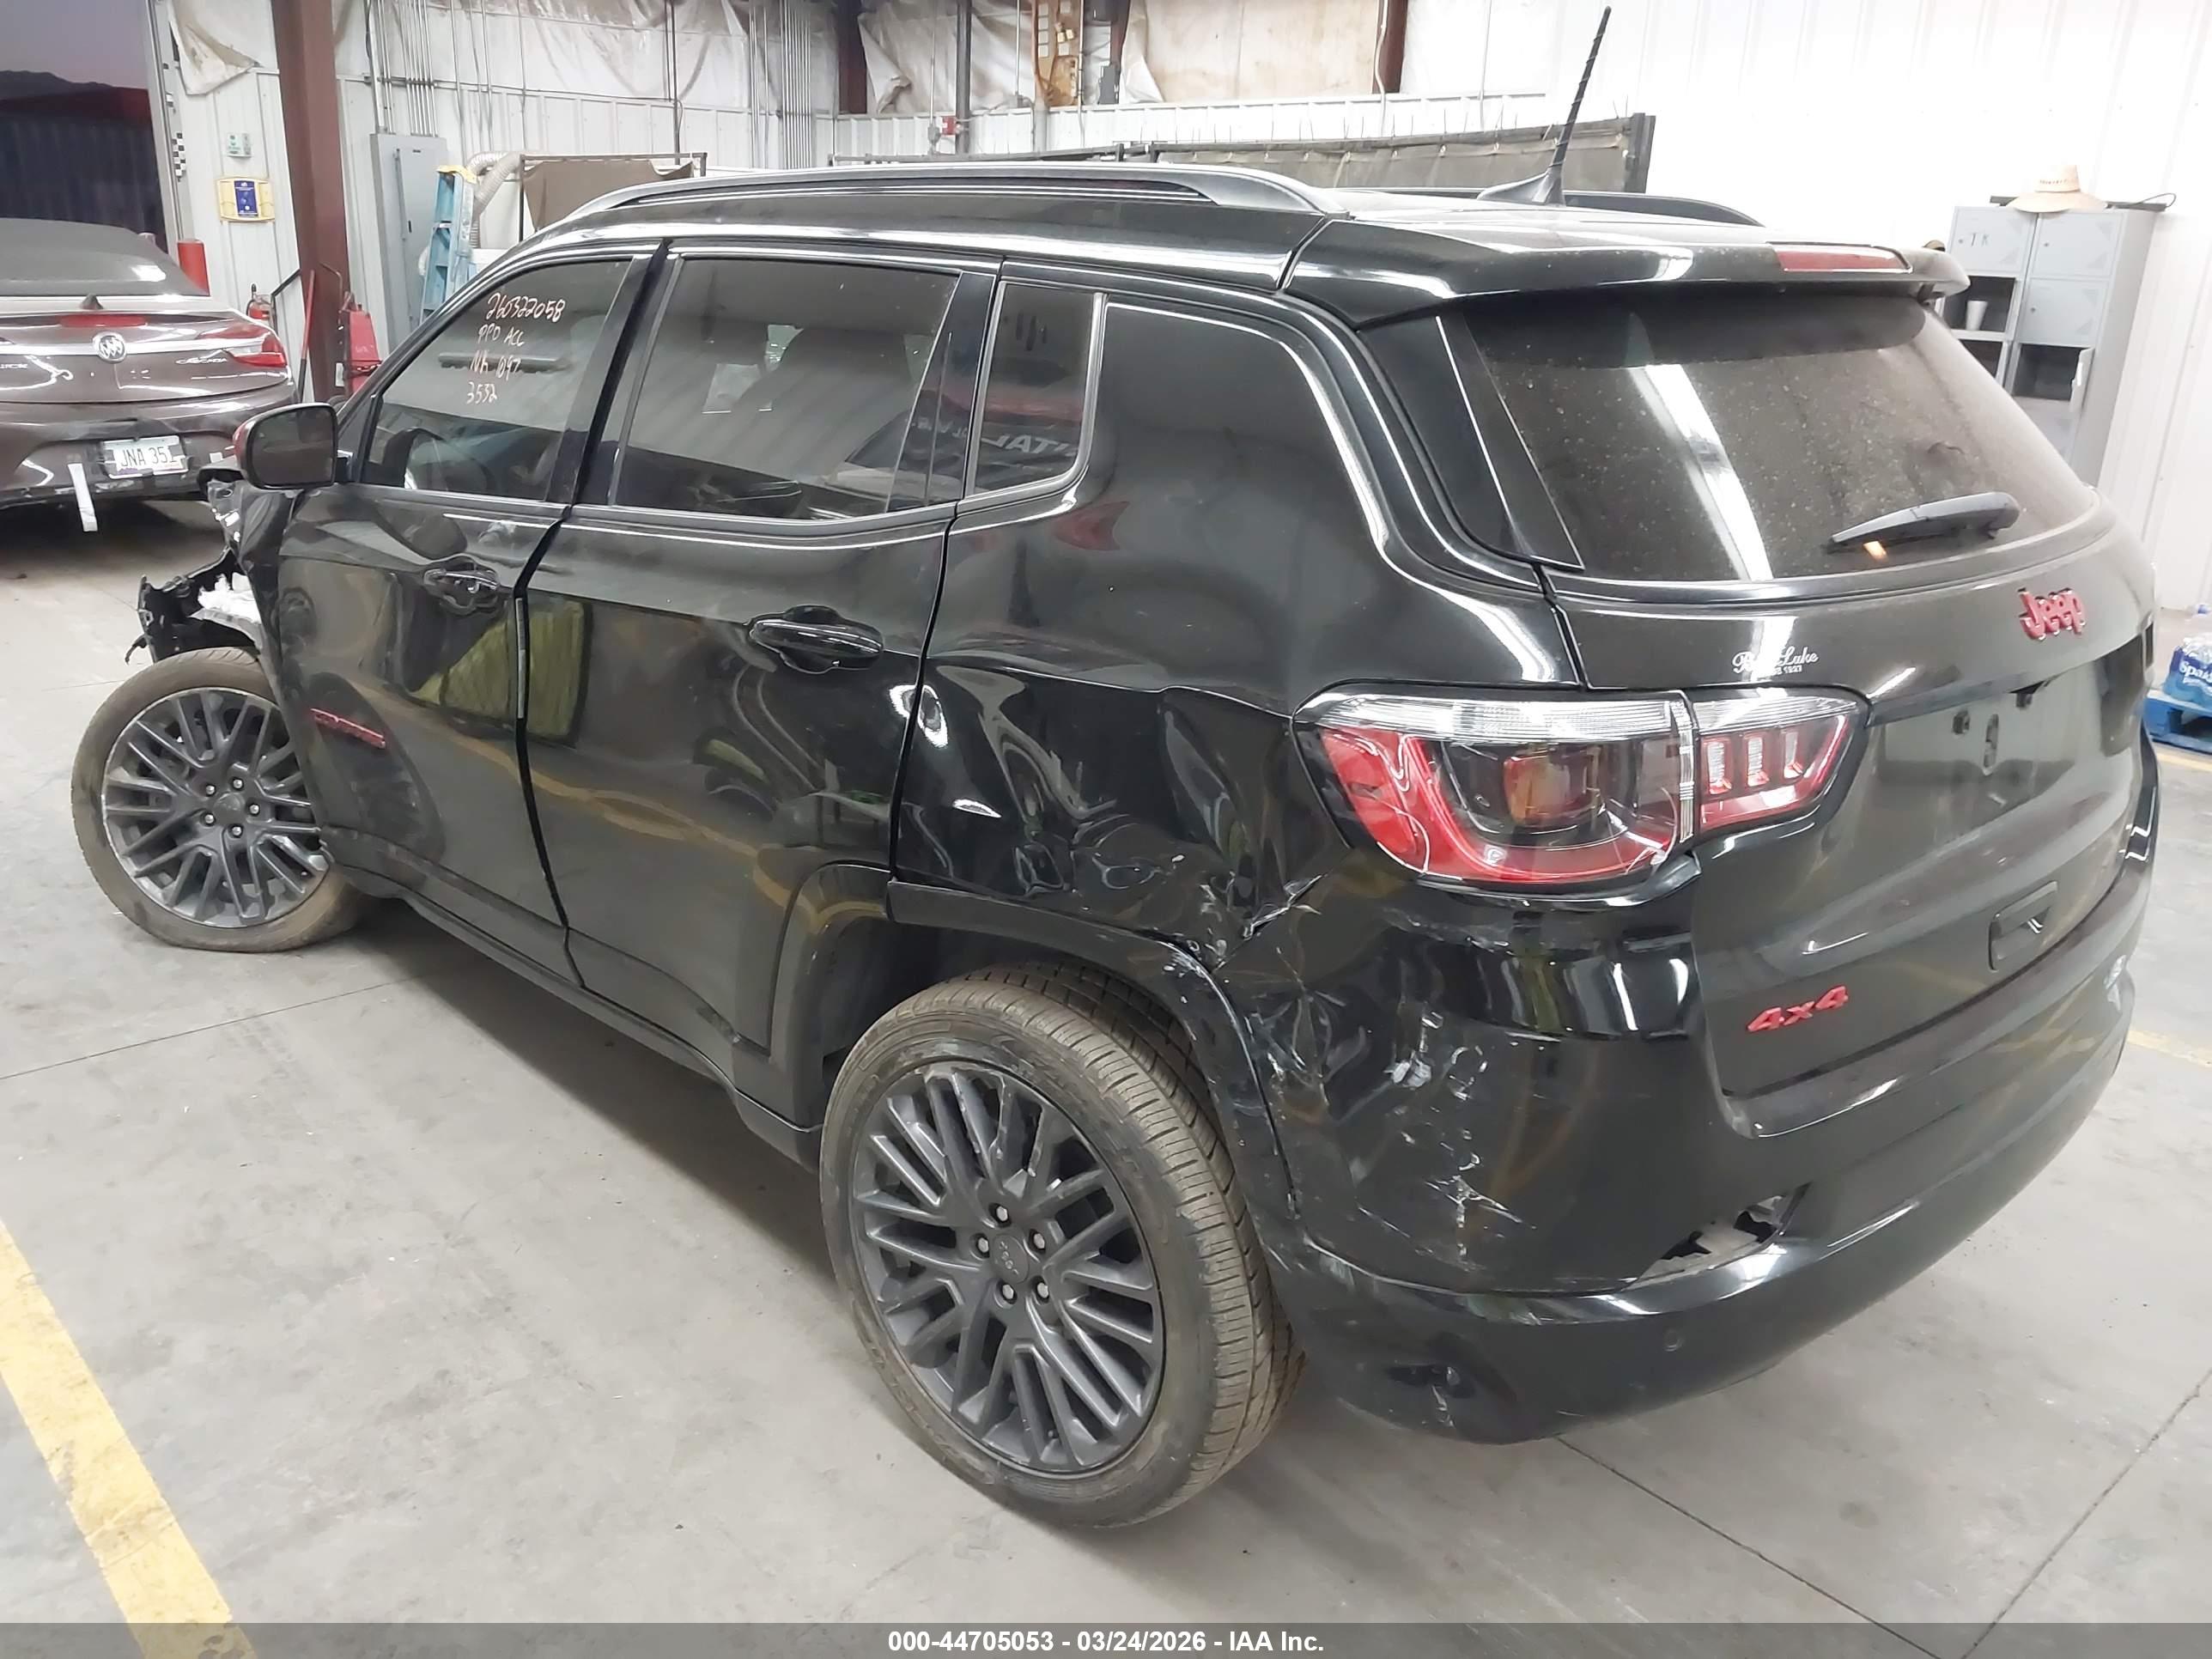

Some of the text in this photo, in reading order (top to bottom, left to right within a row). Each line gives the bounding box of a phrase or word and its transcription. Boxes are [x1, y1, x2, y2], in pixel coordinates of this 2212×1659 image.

[485, 292, 566, 323] 260322058
[120, 448, 147, 468] JNA
[2018, 588, 2086, 641] Jeep
